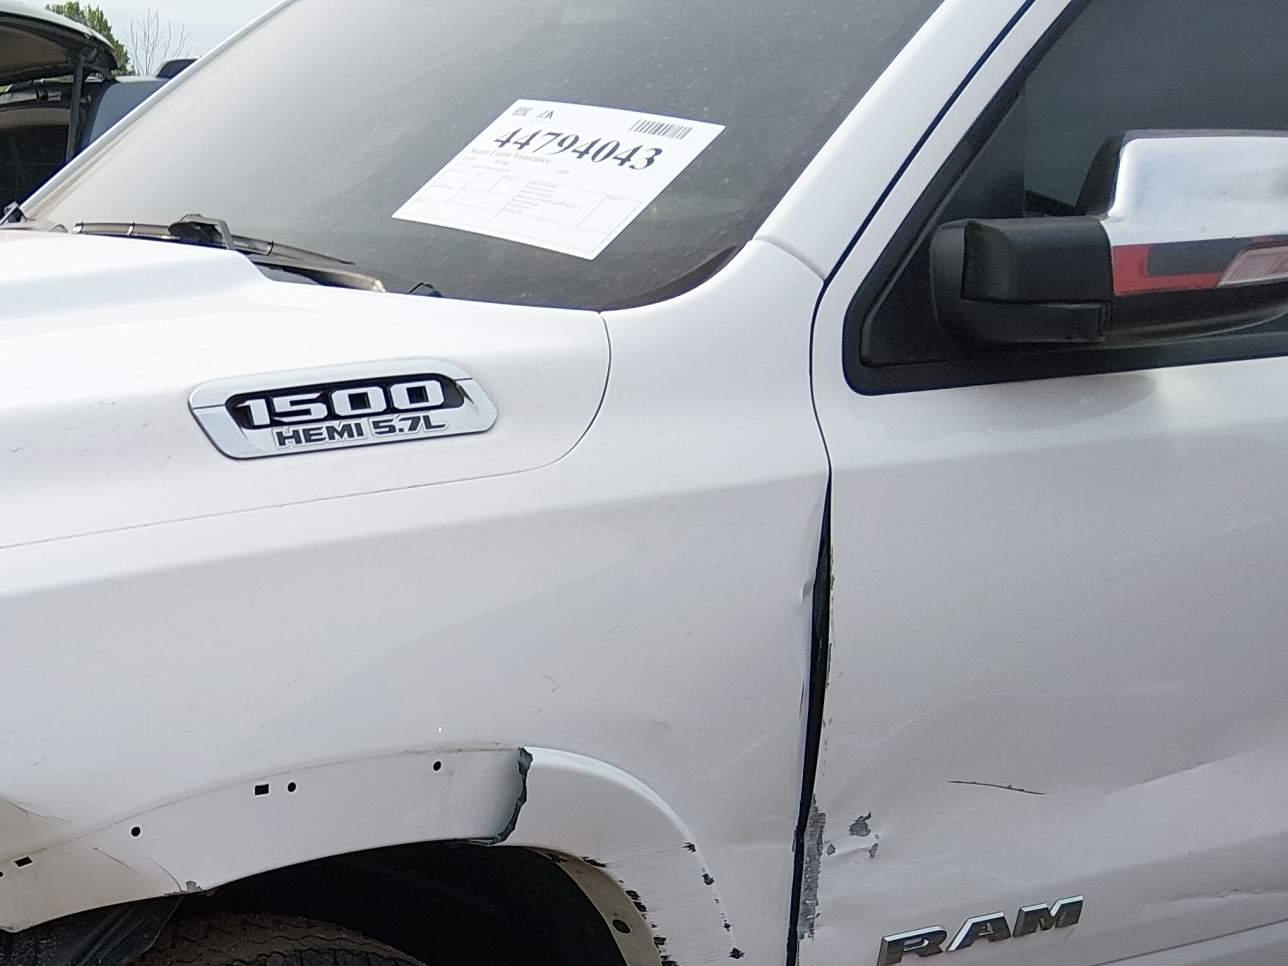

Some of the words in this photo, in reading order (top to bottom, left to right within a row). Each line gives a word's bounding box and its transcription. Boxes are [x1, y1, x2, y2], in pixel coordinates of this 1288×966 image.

[494, 127, 663, 170] 44794043
[234, 379, 445, 426] 1500
[274, 421, 364, 448] HEMI
[372, 413, 447, 437] 5.7L
